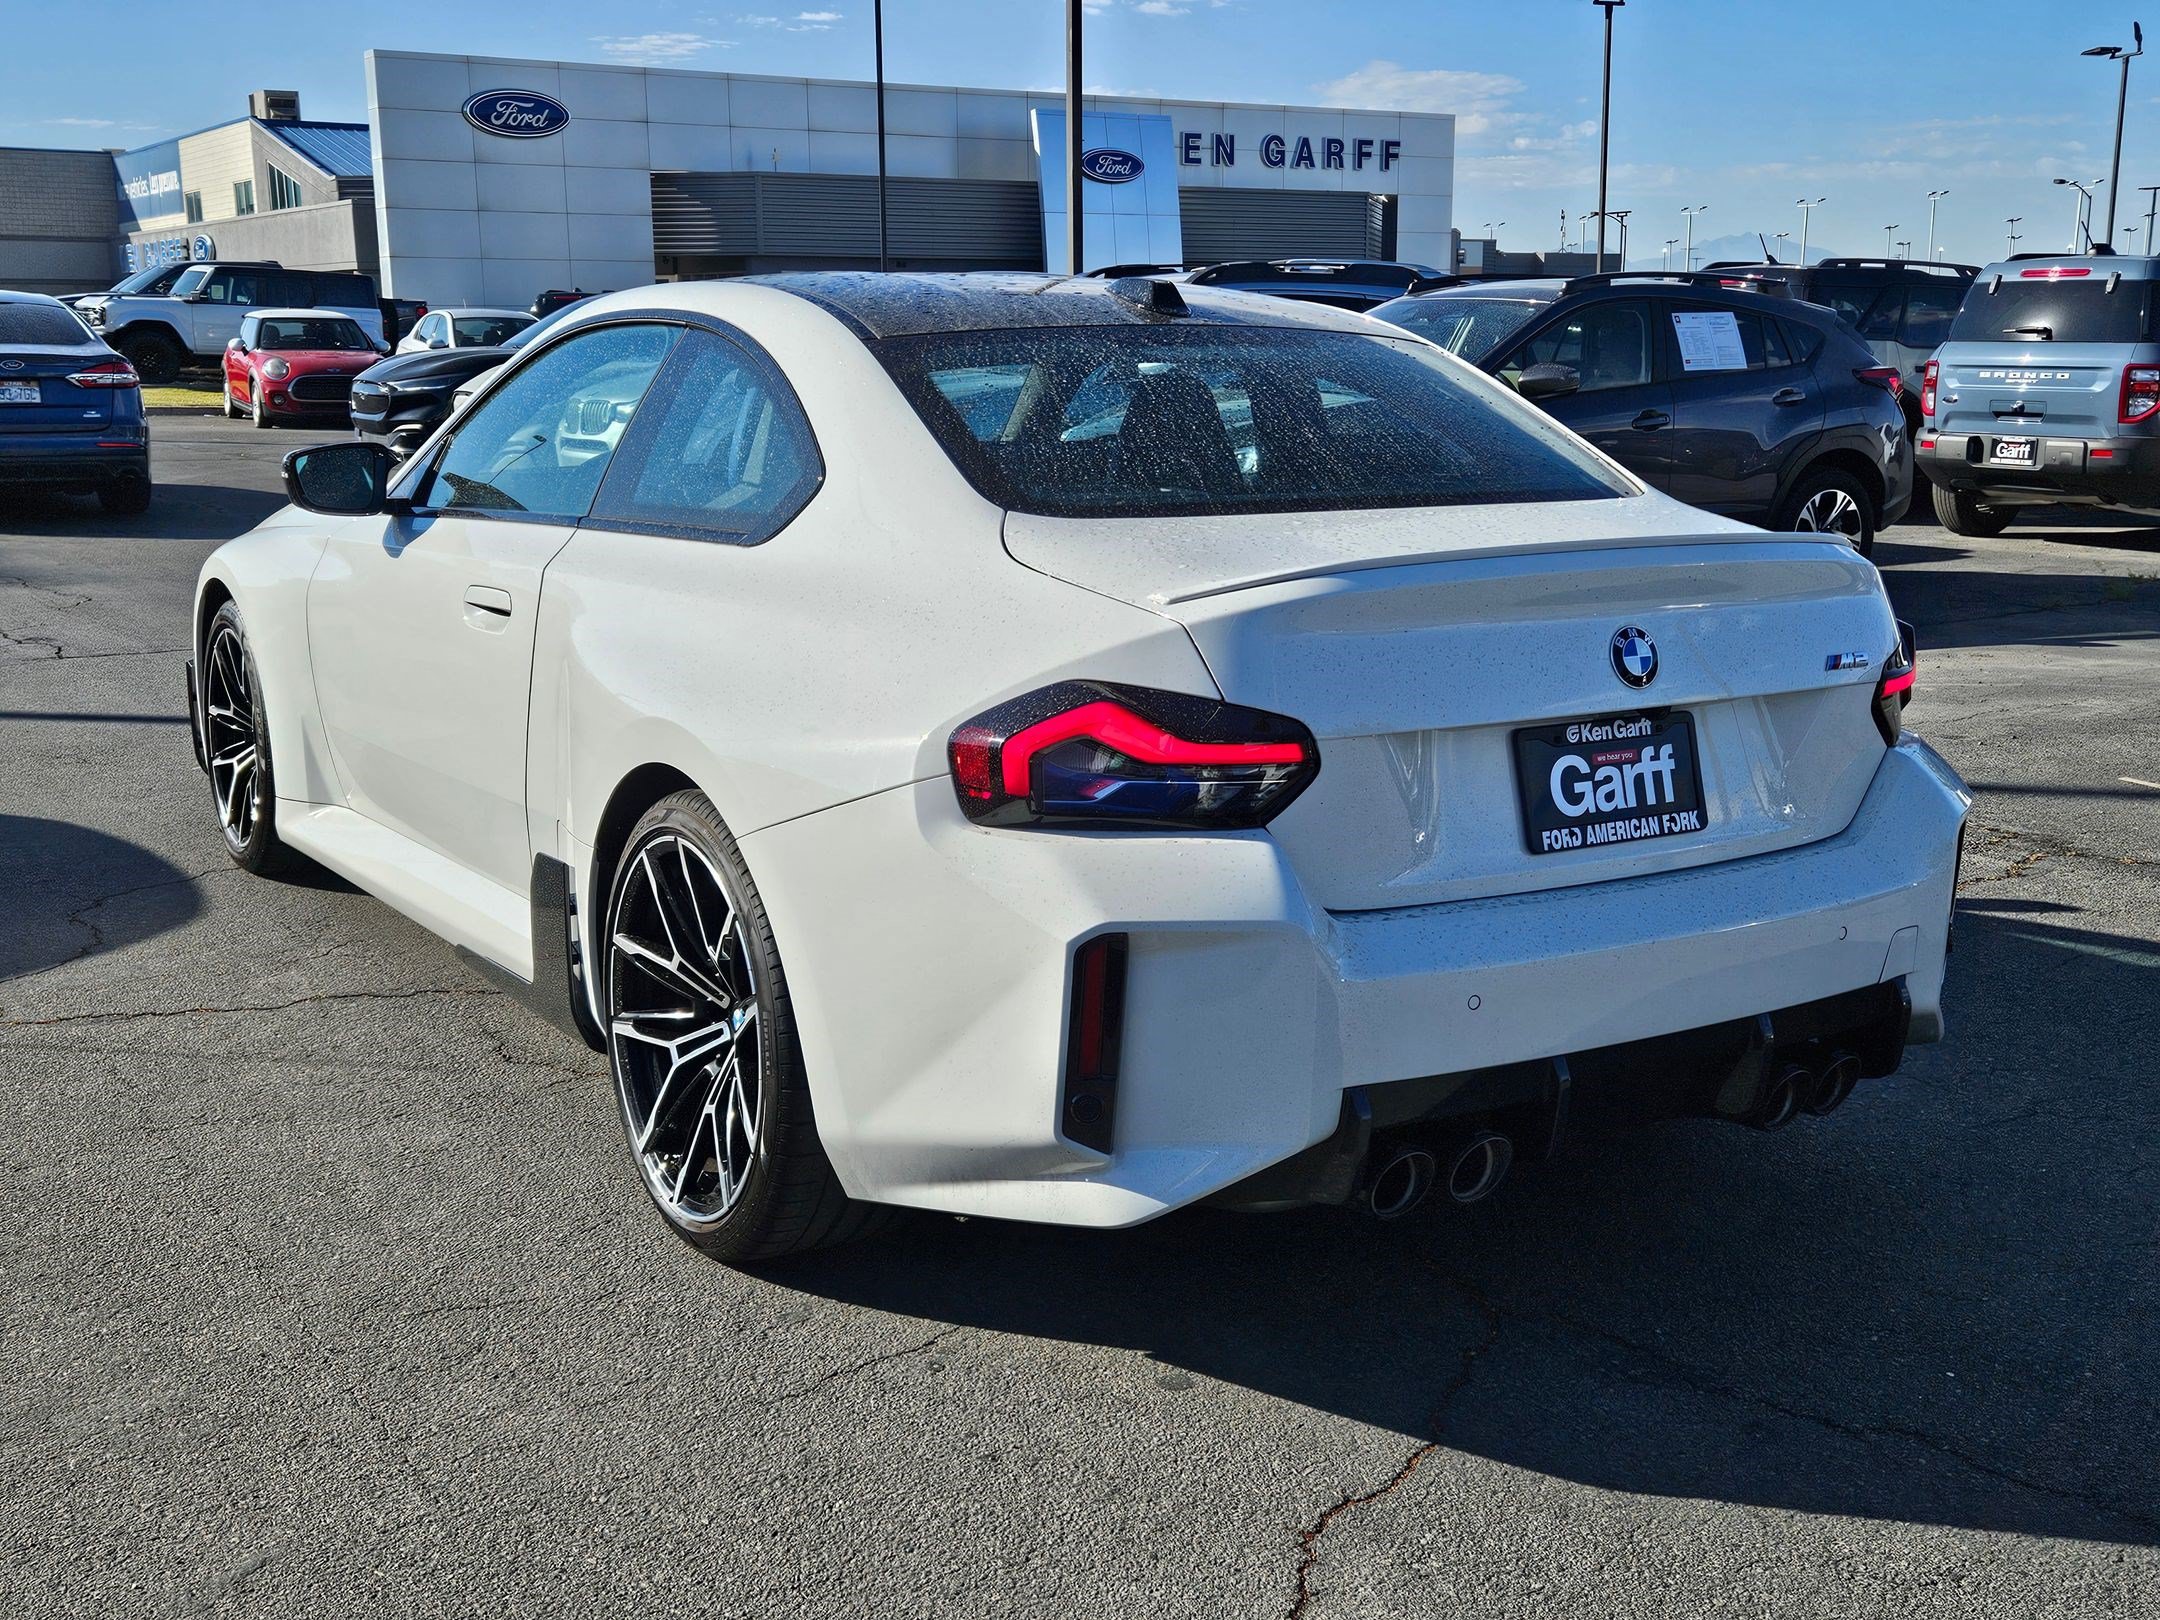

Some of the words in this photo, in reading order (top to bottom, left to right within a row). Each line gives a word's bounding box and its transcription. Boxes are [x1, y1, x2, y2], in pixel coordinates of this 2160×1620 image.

[491, 100, 549, 127] Ford
[1261, 134, 1401, 171] GARFF
[1096, 155, 1132, 175] Ford
[1979, 371, 2070, 379] BRONCO
[1996, 442, 2031, 459] Garff
[1615, 628, 1653, 648] BMW
[1580, 722, 1613, 743] Ken
[1613, 717, 1652, 739] Garff
[1606, 753, 1620, 761] hear
[1621, 752, 1633, 760] you
[1550, 743, 1675, 818] Garff
[1541, 827, 1582, 851] FORD
[1586, 816, 1660, 845] AMERICAN
[1661, 810, 1701, 834] FORK
